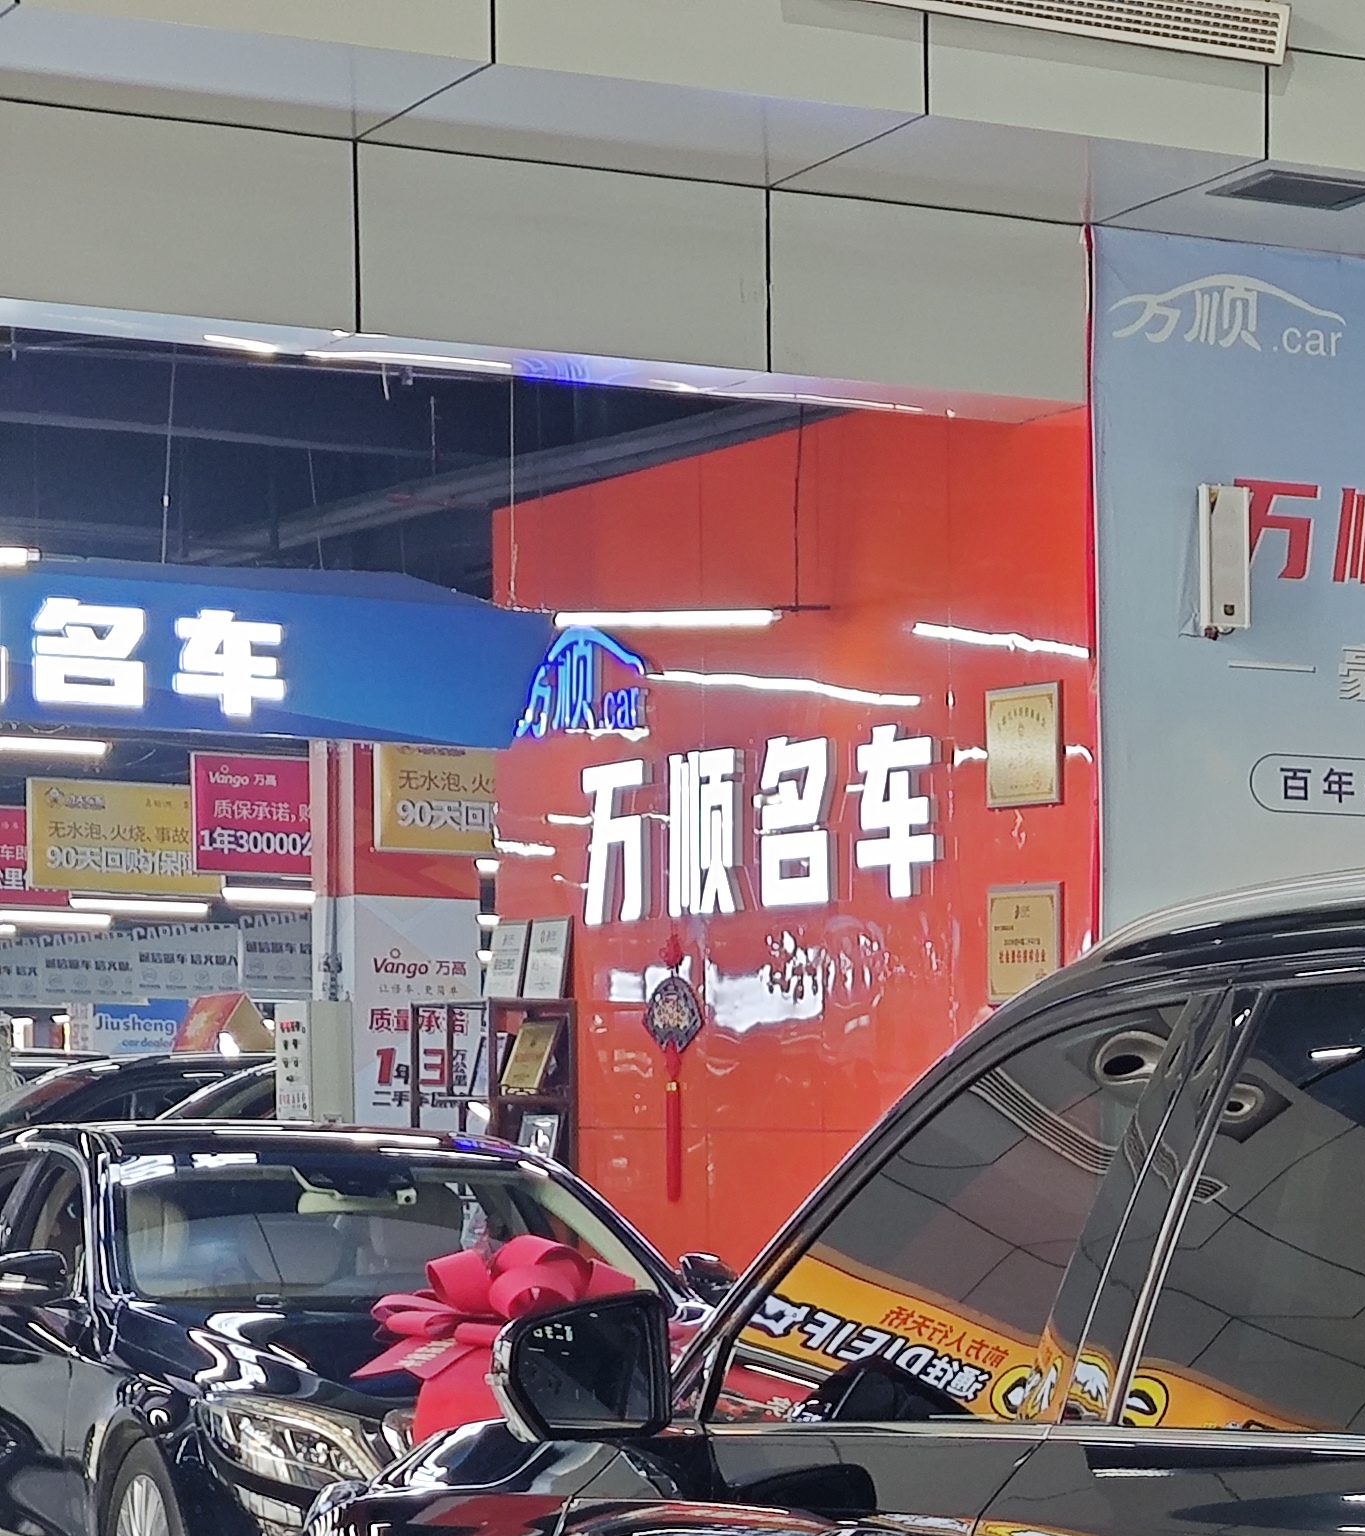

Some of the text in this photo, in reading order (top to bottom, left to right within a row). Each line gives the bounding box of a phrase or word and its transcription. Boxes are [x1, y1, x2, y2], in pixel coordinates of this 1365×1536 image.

[0, 597, 286, 716] 名车
[208, 764, 250, 787] Vango
[398, 769, 495, 794] 无水泡、火
[396, 799, 495, 832] 90天回
[582, 723, 942, 926] 万顺名车
[374, 948, 467, 979] Vango 万高
[95, 1013, 177, 1036] Jiusheng
